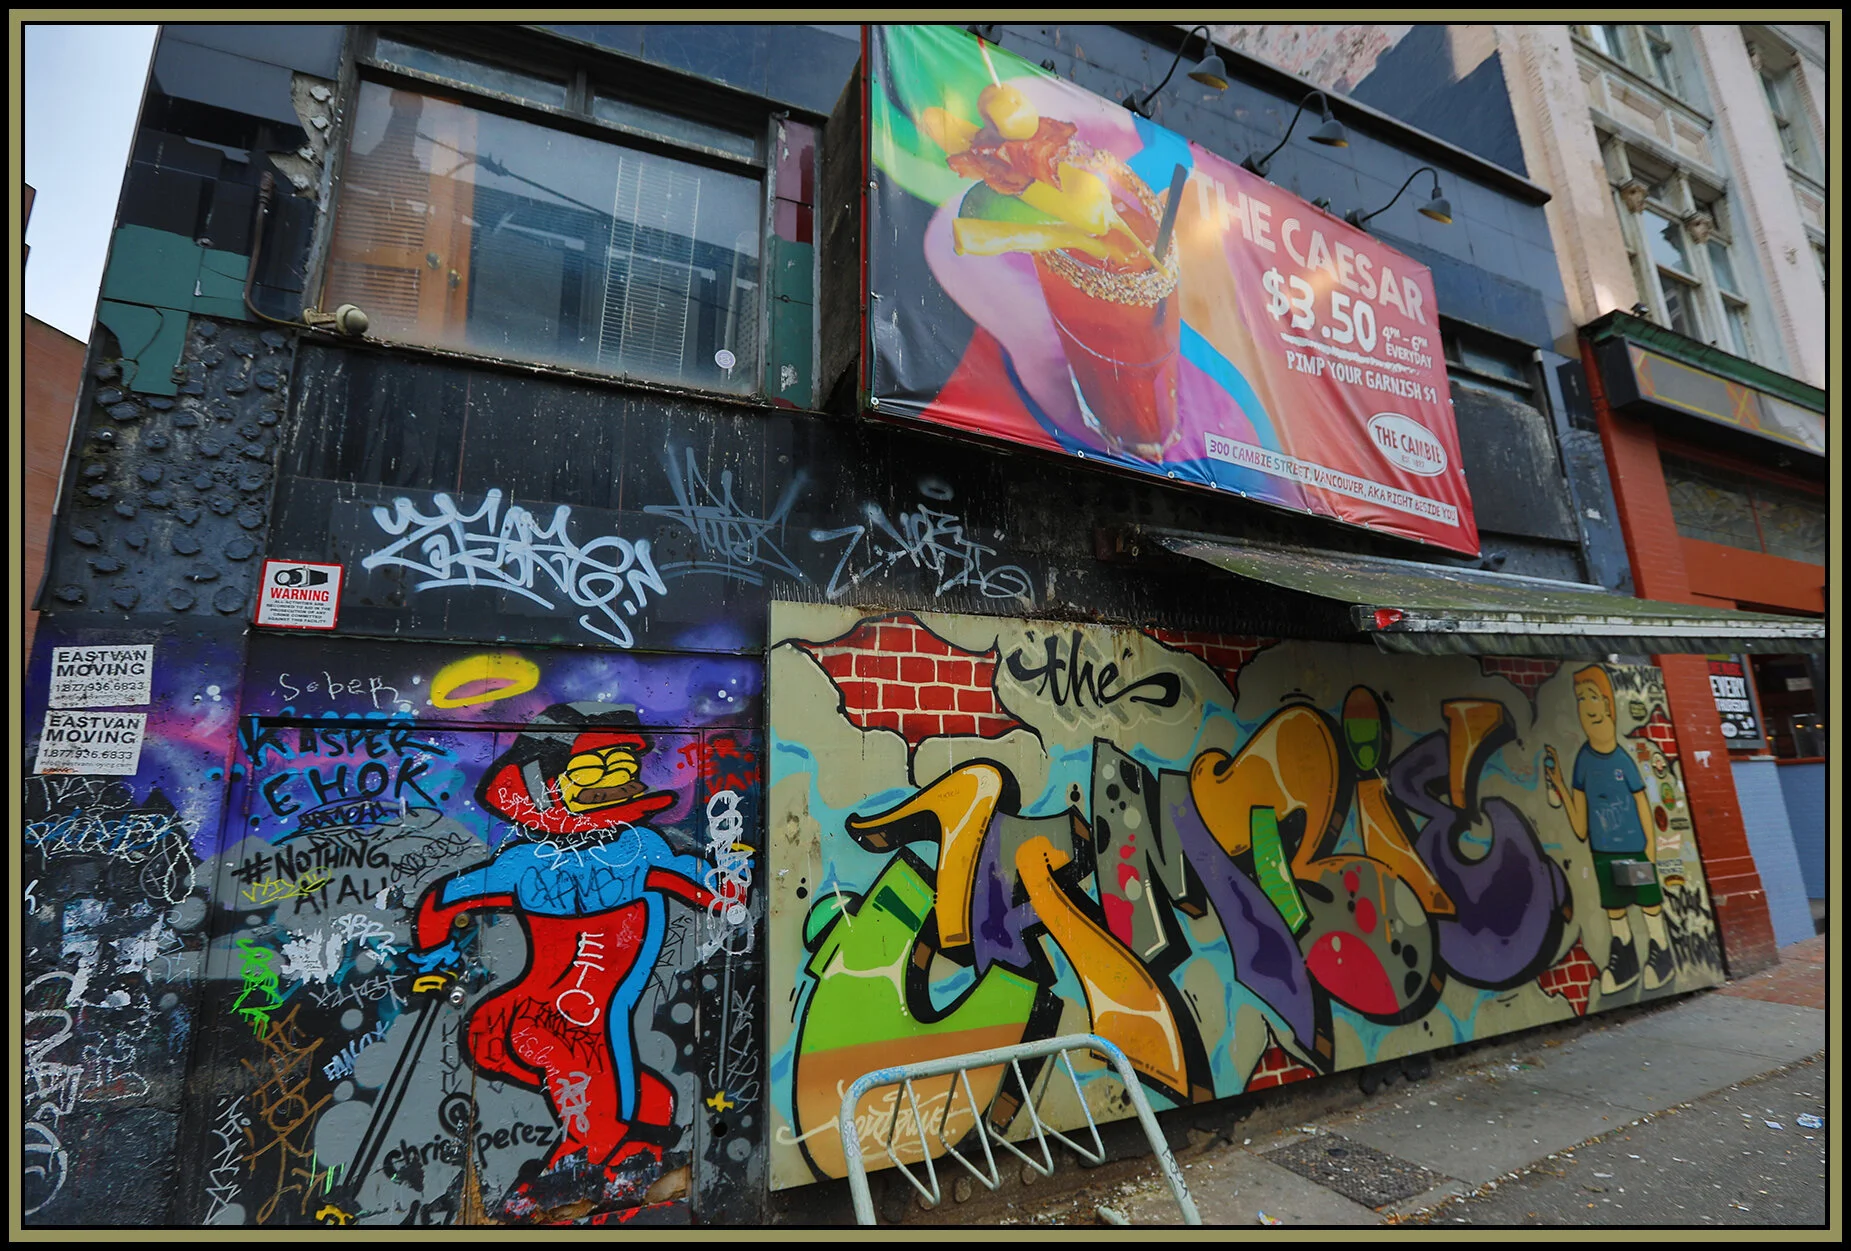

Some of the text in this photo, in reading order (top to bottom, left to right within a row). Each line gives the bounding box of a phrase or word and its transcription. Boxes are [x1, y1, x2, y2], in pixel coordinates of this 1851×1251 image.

[1192, 169, 1427, 326] THE CAESAR
[1262, 267, 1377, 353] $3.50
[1286, 350, 1438, 404] PIMP YOUR GARNISH $1
[1385, 342, 1433, 369] EVERYDAY
[1375, 424, 1442, 464] THE CAMBIE
[1210, 439, 1230, 456] 300
[1232, 446, 1272, 469] CAMBIE
[1274, 457, 1314, 481] STREET,
[1313, 468, 1367, 498] VANCOUVER,
[1387, 491, 1414, 509] RIGHT
[1415, 499, 1441, 516] BESIDE
[1441, 507, 1457, 521] YOU
[270, 587, 330, 602] WARNING
[56, 663, 145, 677] MOVING
[1005, 629, 1182, 708] the
[45, 729, 136, 744] MOVING
[231, 838, 391, 886] #NOTHING
[475, 1121, 555, 1170] perez
